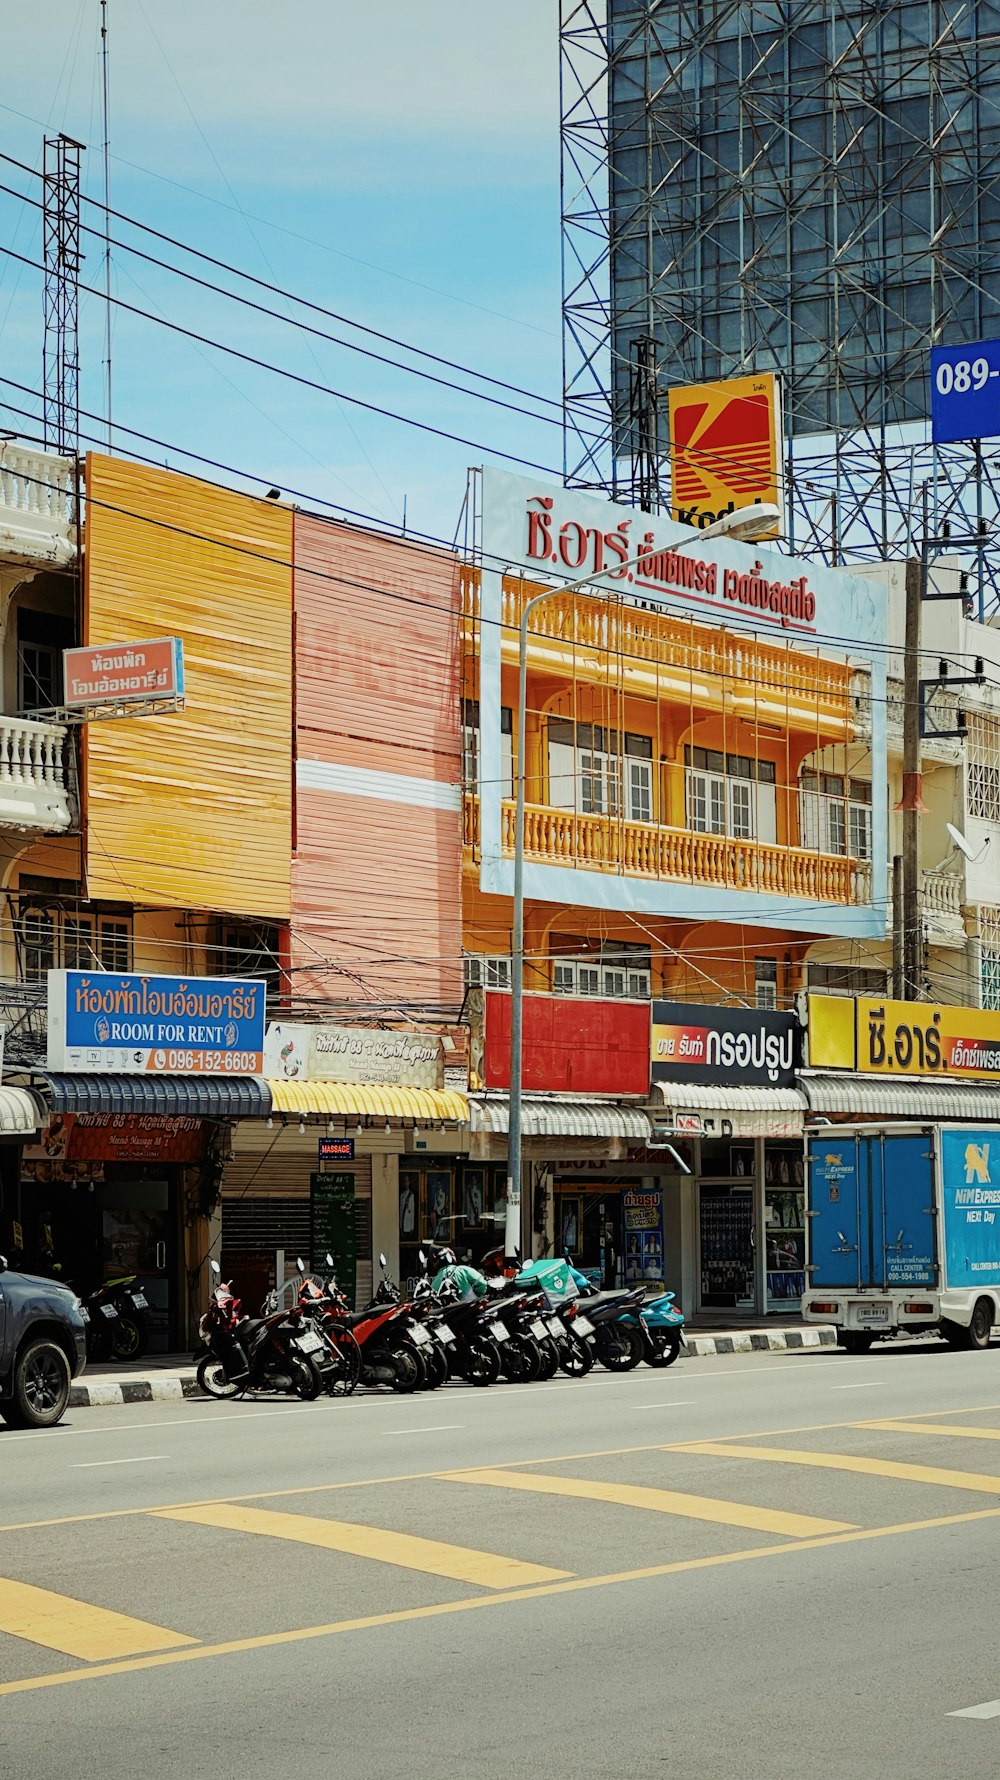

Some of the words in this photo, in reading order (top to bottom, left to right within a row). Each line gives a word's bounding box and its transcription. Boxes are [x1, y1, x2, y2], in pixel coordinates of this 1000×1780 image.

[91, 650, 146, 673] ห้องพัก
[75, 976, 257, 1020] ห้องพักโอบอ้อมอารีย์
[111, 1022, 155, 1041] ROOM
[158, 1024, 185, 1042] FOR
[188, 1025, 223, 1043] RENT
[350, 1039, 363, 1055] 88
[656, 1037, 676, 1056] ขาย
[678, 1034, 703, 1057] รับทำ
[168, 1050, 257, 1071] 096-152-6603
[112, 1114, 125, 1128] 88
[321, 1144, 351, 1154] MASSAGE
[890, 1264, 903, 1272] CALL
[903, 1264, 923, 1272] CENTER
